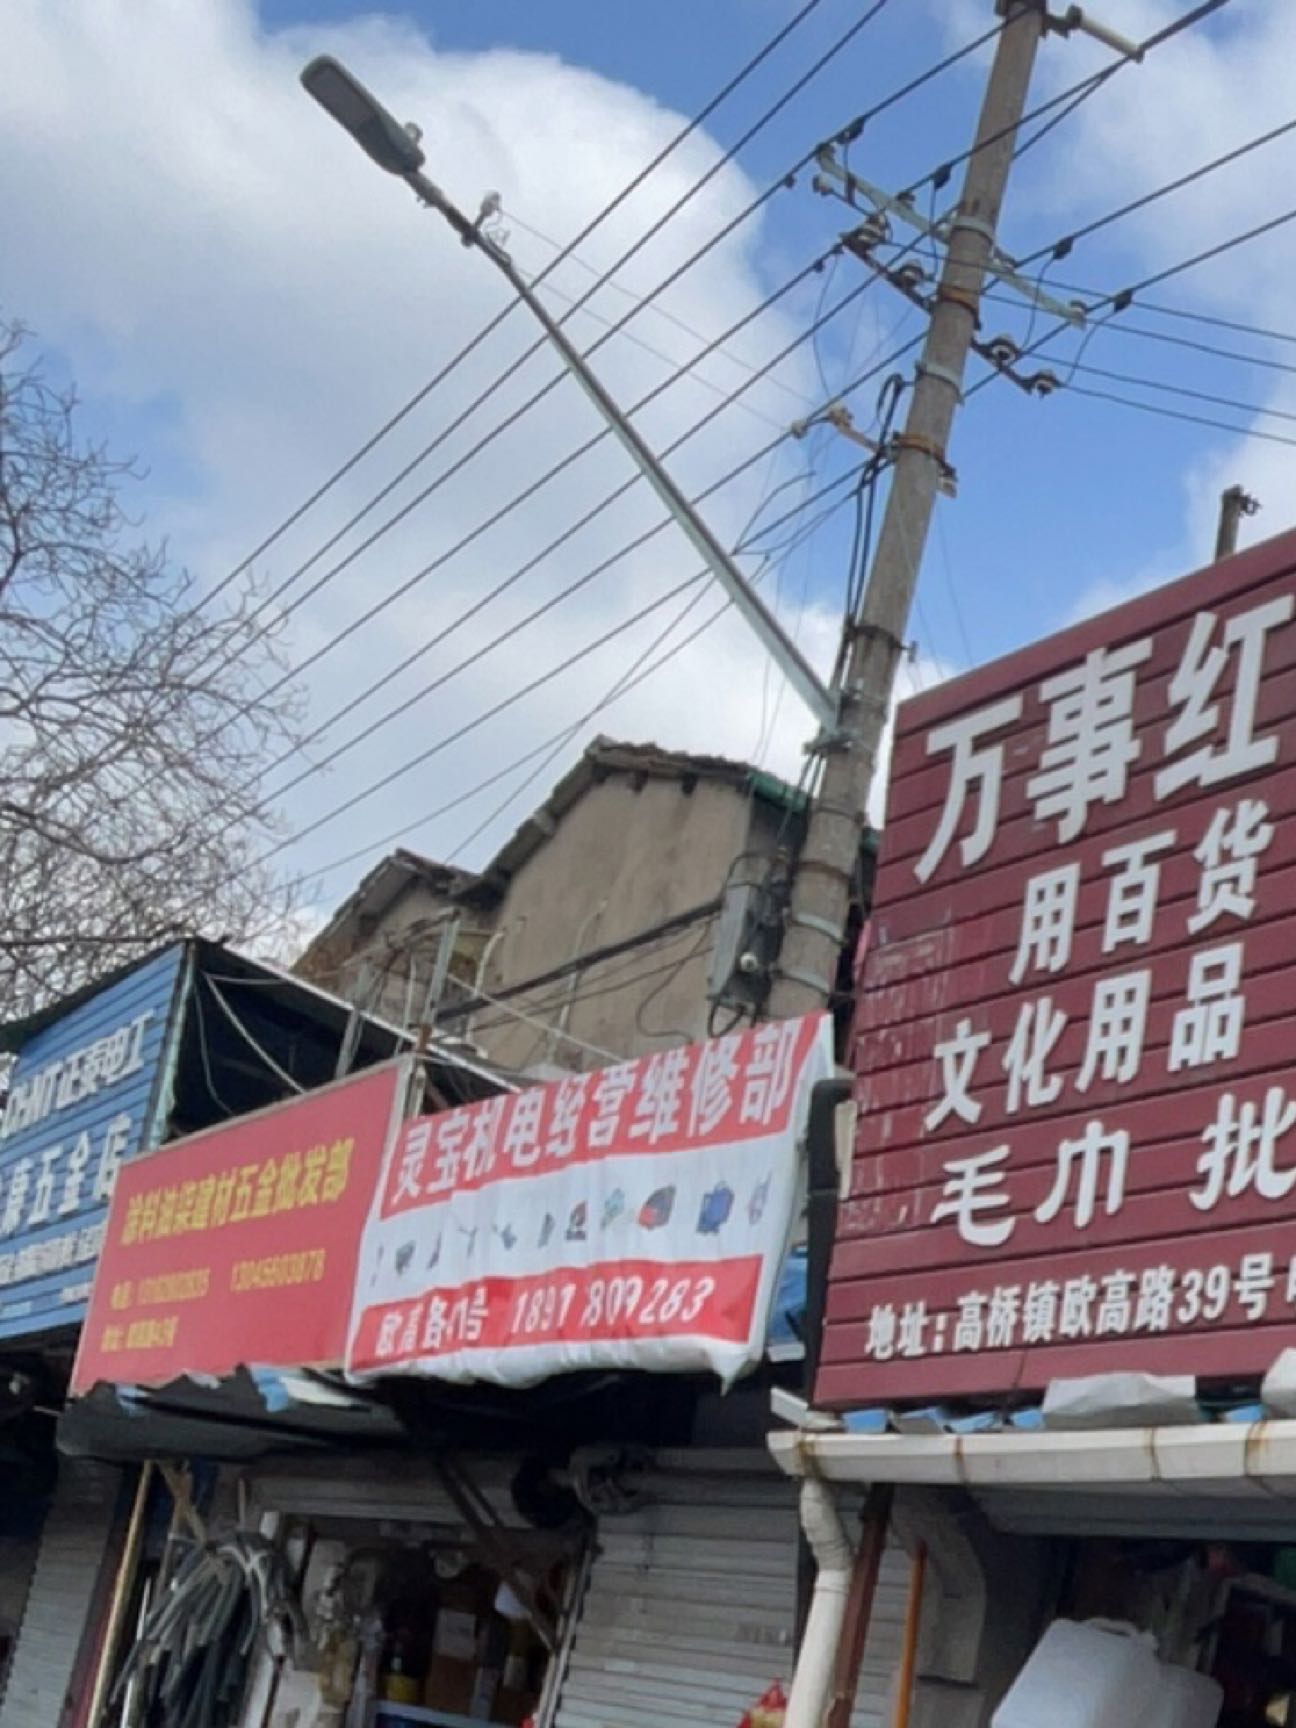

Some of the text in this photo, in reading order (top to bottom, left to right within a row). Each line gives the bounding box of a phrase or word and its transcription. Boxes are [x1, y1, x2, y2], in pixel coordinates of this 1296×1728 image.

[1009, 799, 1275, 984] 用百货
[923, 942, 1246, 1131] 文化用品
